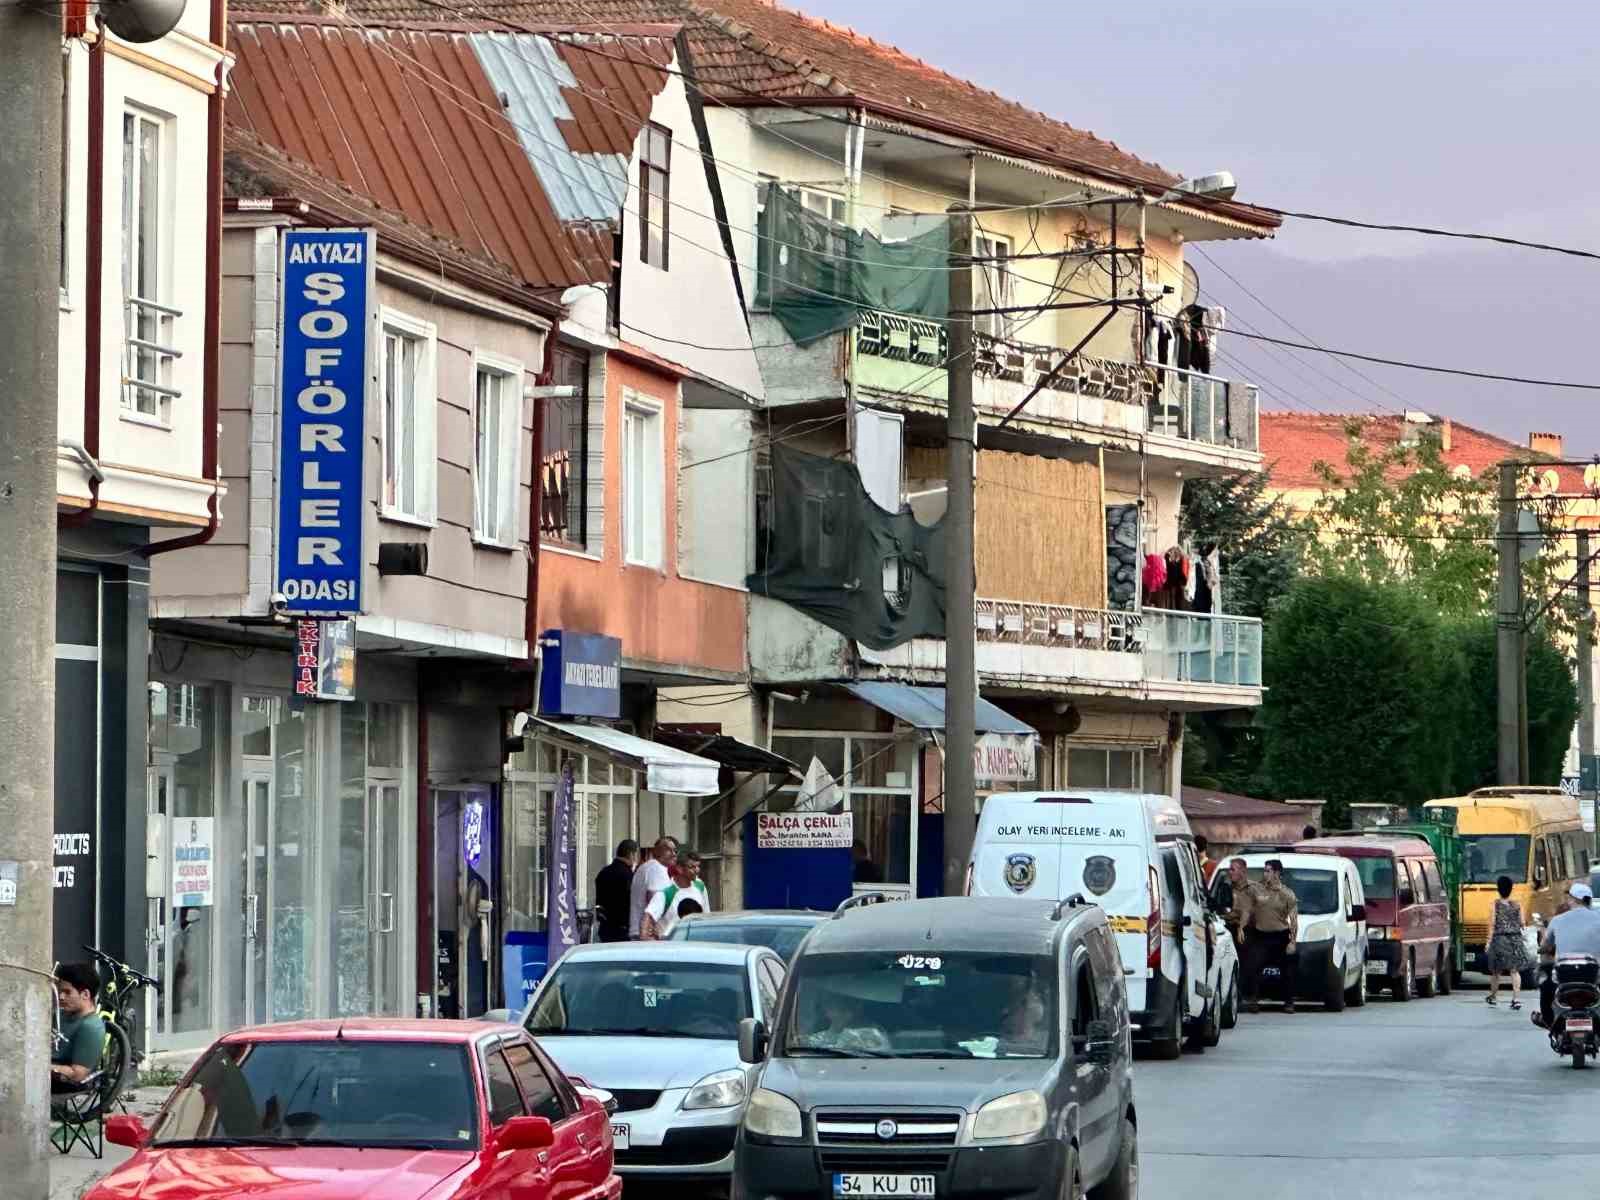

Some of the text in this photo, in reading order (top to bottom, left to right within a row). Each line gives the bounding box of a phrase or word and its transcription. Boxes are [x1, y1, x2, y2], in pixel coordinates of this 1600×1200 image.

[289, 243, 362, 264] AKYAZI
[297, 272, 348, 566] ŞOFÖRLER
[282, 579, 355, 601] ODASI
[759, 815, 800, 831] SALÇA
[996, 825, 1022, 836] OLAY
[842, 1175, 933, 1193] 54 KU 011
